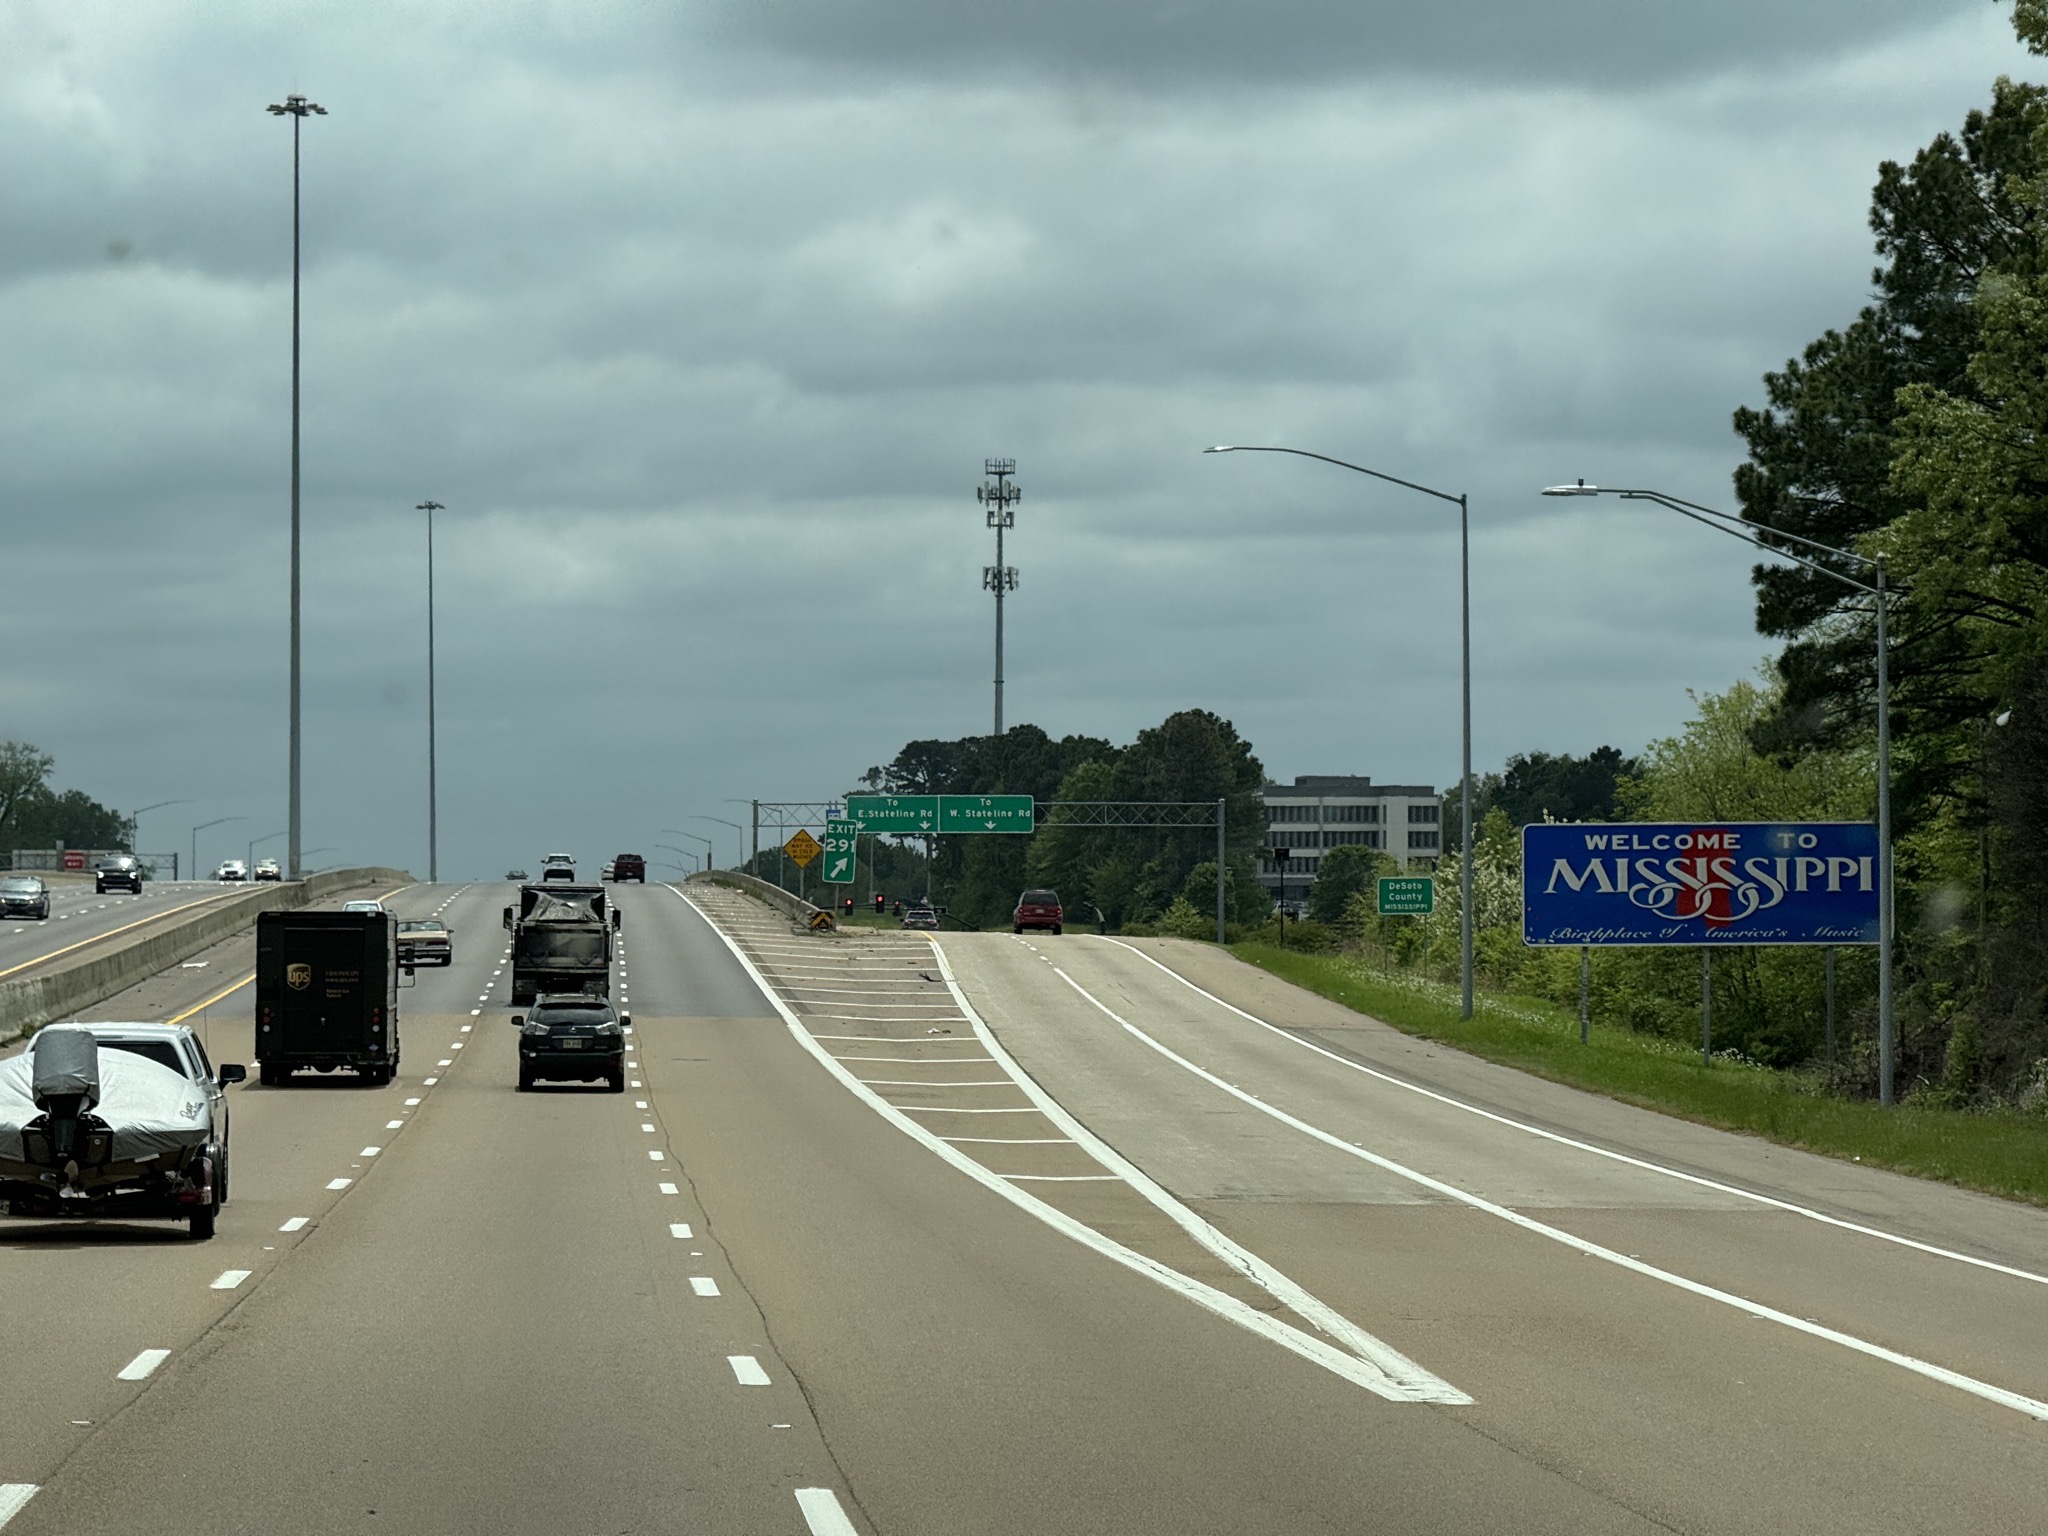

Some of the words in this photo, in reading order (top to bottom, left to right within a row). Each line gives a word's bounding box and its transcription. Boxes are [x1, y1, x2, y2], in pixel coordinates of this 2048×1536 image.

[920, 809, 933, 818] Rd
[965, 809, 1012, 818] Stateline
[1018, 809, 1031, 818] Rd
[828, 823, 855, 834] EXIT
[826, 838, 855, 853] 291
[1585, 834, 1741, 850] WELCOME
[1777, 833, 1818, 849] TO
[1389, 882, 1422, 890] DeSoto
[1543, 856, 1874, 921] MISSISSIPPI
[1389, 893, 1423, 902] County
[1549, 925, 1652, 942] Birthplace
[1659, 923, 1687, 939] of
[1690, 926, 1788, 939] America's
[1802, 926, 1865, 939] Music
[289, 971, 309, 987] ups
